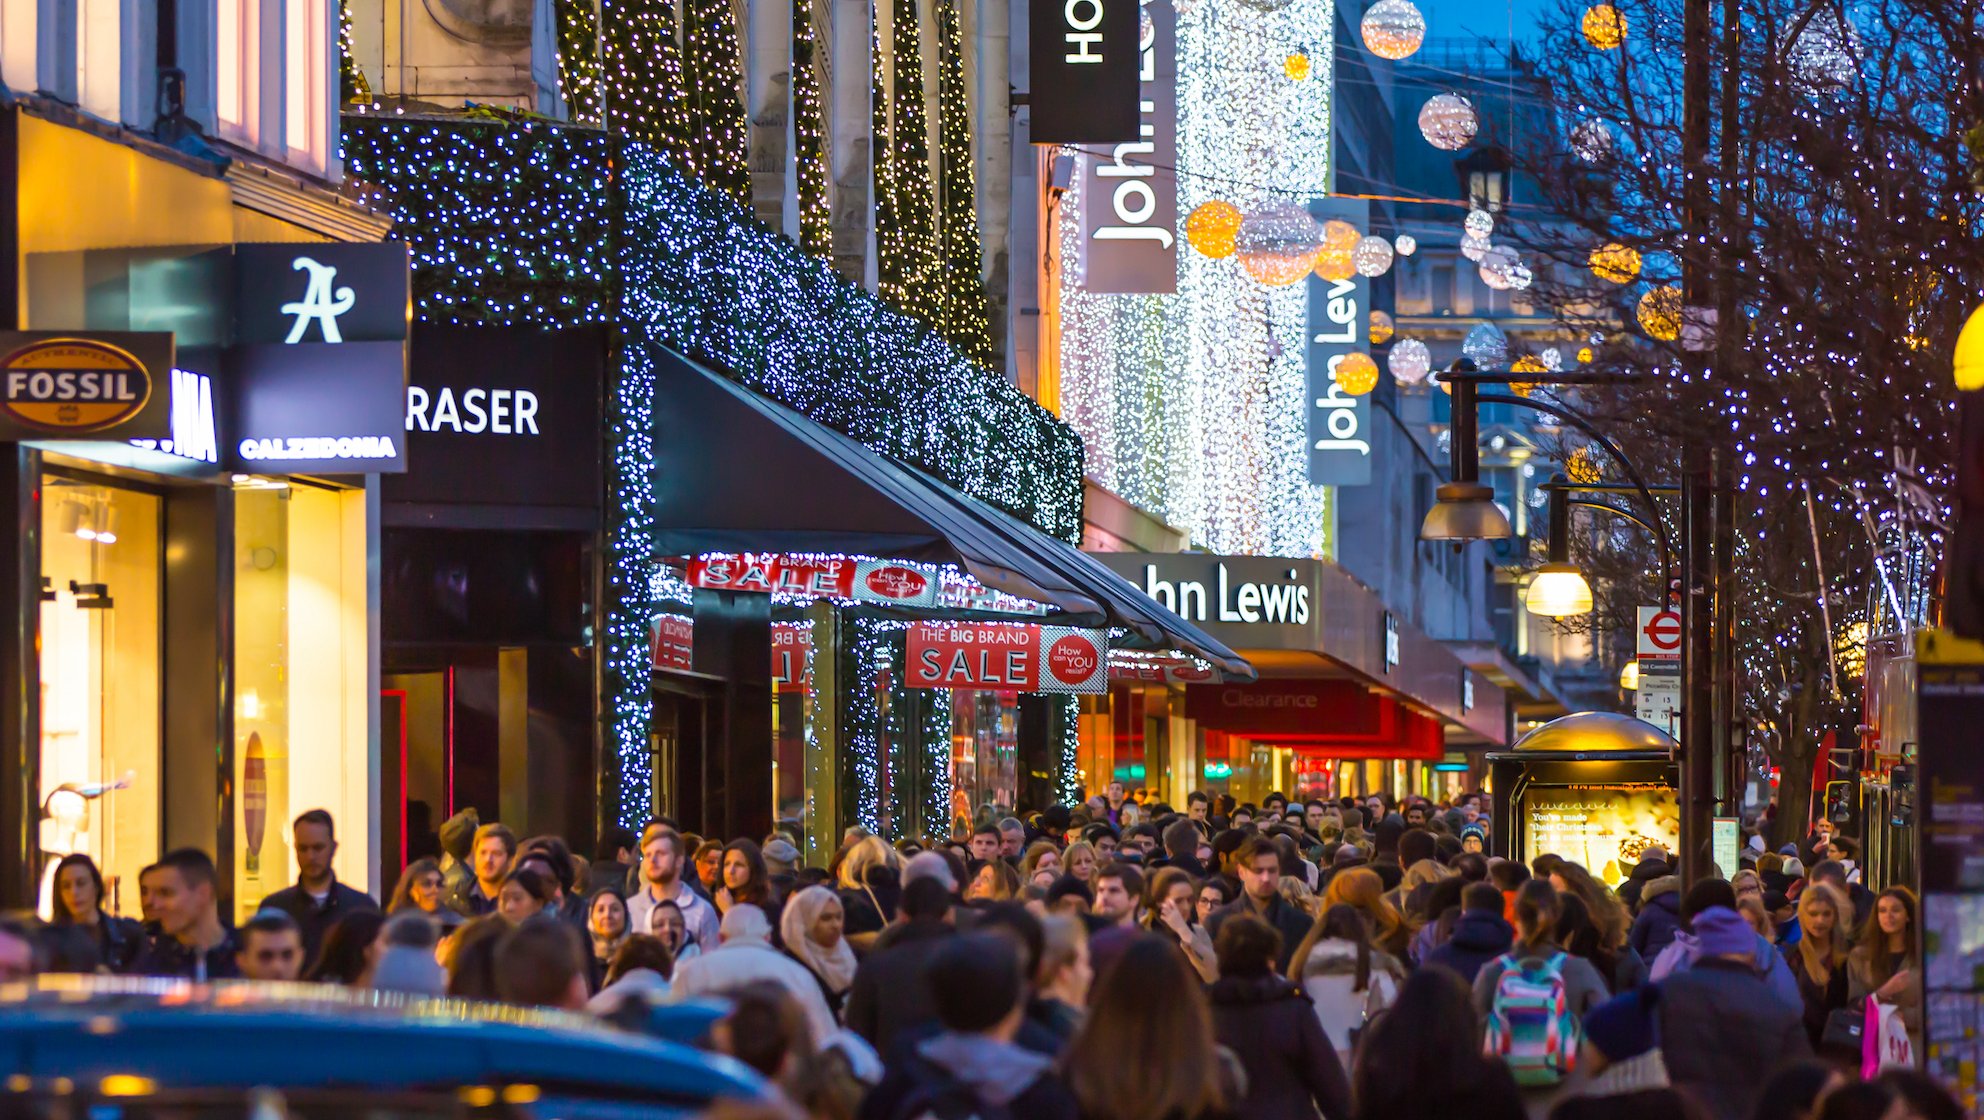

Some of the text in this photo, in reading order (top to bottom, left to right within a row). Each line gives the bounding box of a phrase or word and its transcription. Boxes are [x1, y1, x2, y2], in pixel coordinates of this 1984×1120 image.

[7, 372, 136, 399] FOSSIL
[405, 386, 540, 434] RASER
[238, 436, 397, 460] CALZEDONIA
[703, 564, 840, 593] SALE
[889, 581, 921, 590] YOU
[1131, 562, 1309, 625] hn Lewis
[920, 628, 1029, 645] THE BIG BRAND
[1058, 645, 1081, 655] How
[919, 647, 1028, 684] SALE
[1067, 656, 1093, 668] YOU
[1222, 688, 1318, 708] Clearance
[1563, 812, 1588, 821] made
